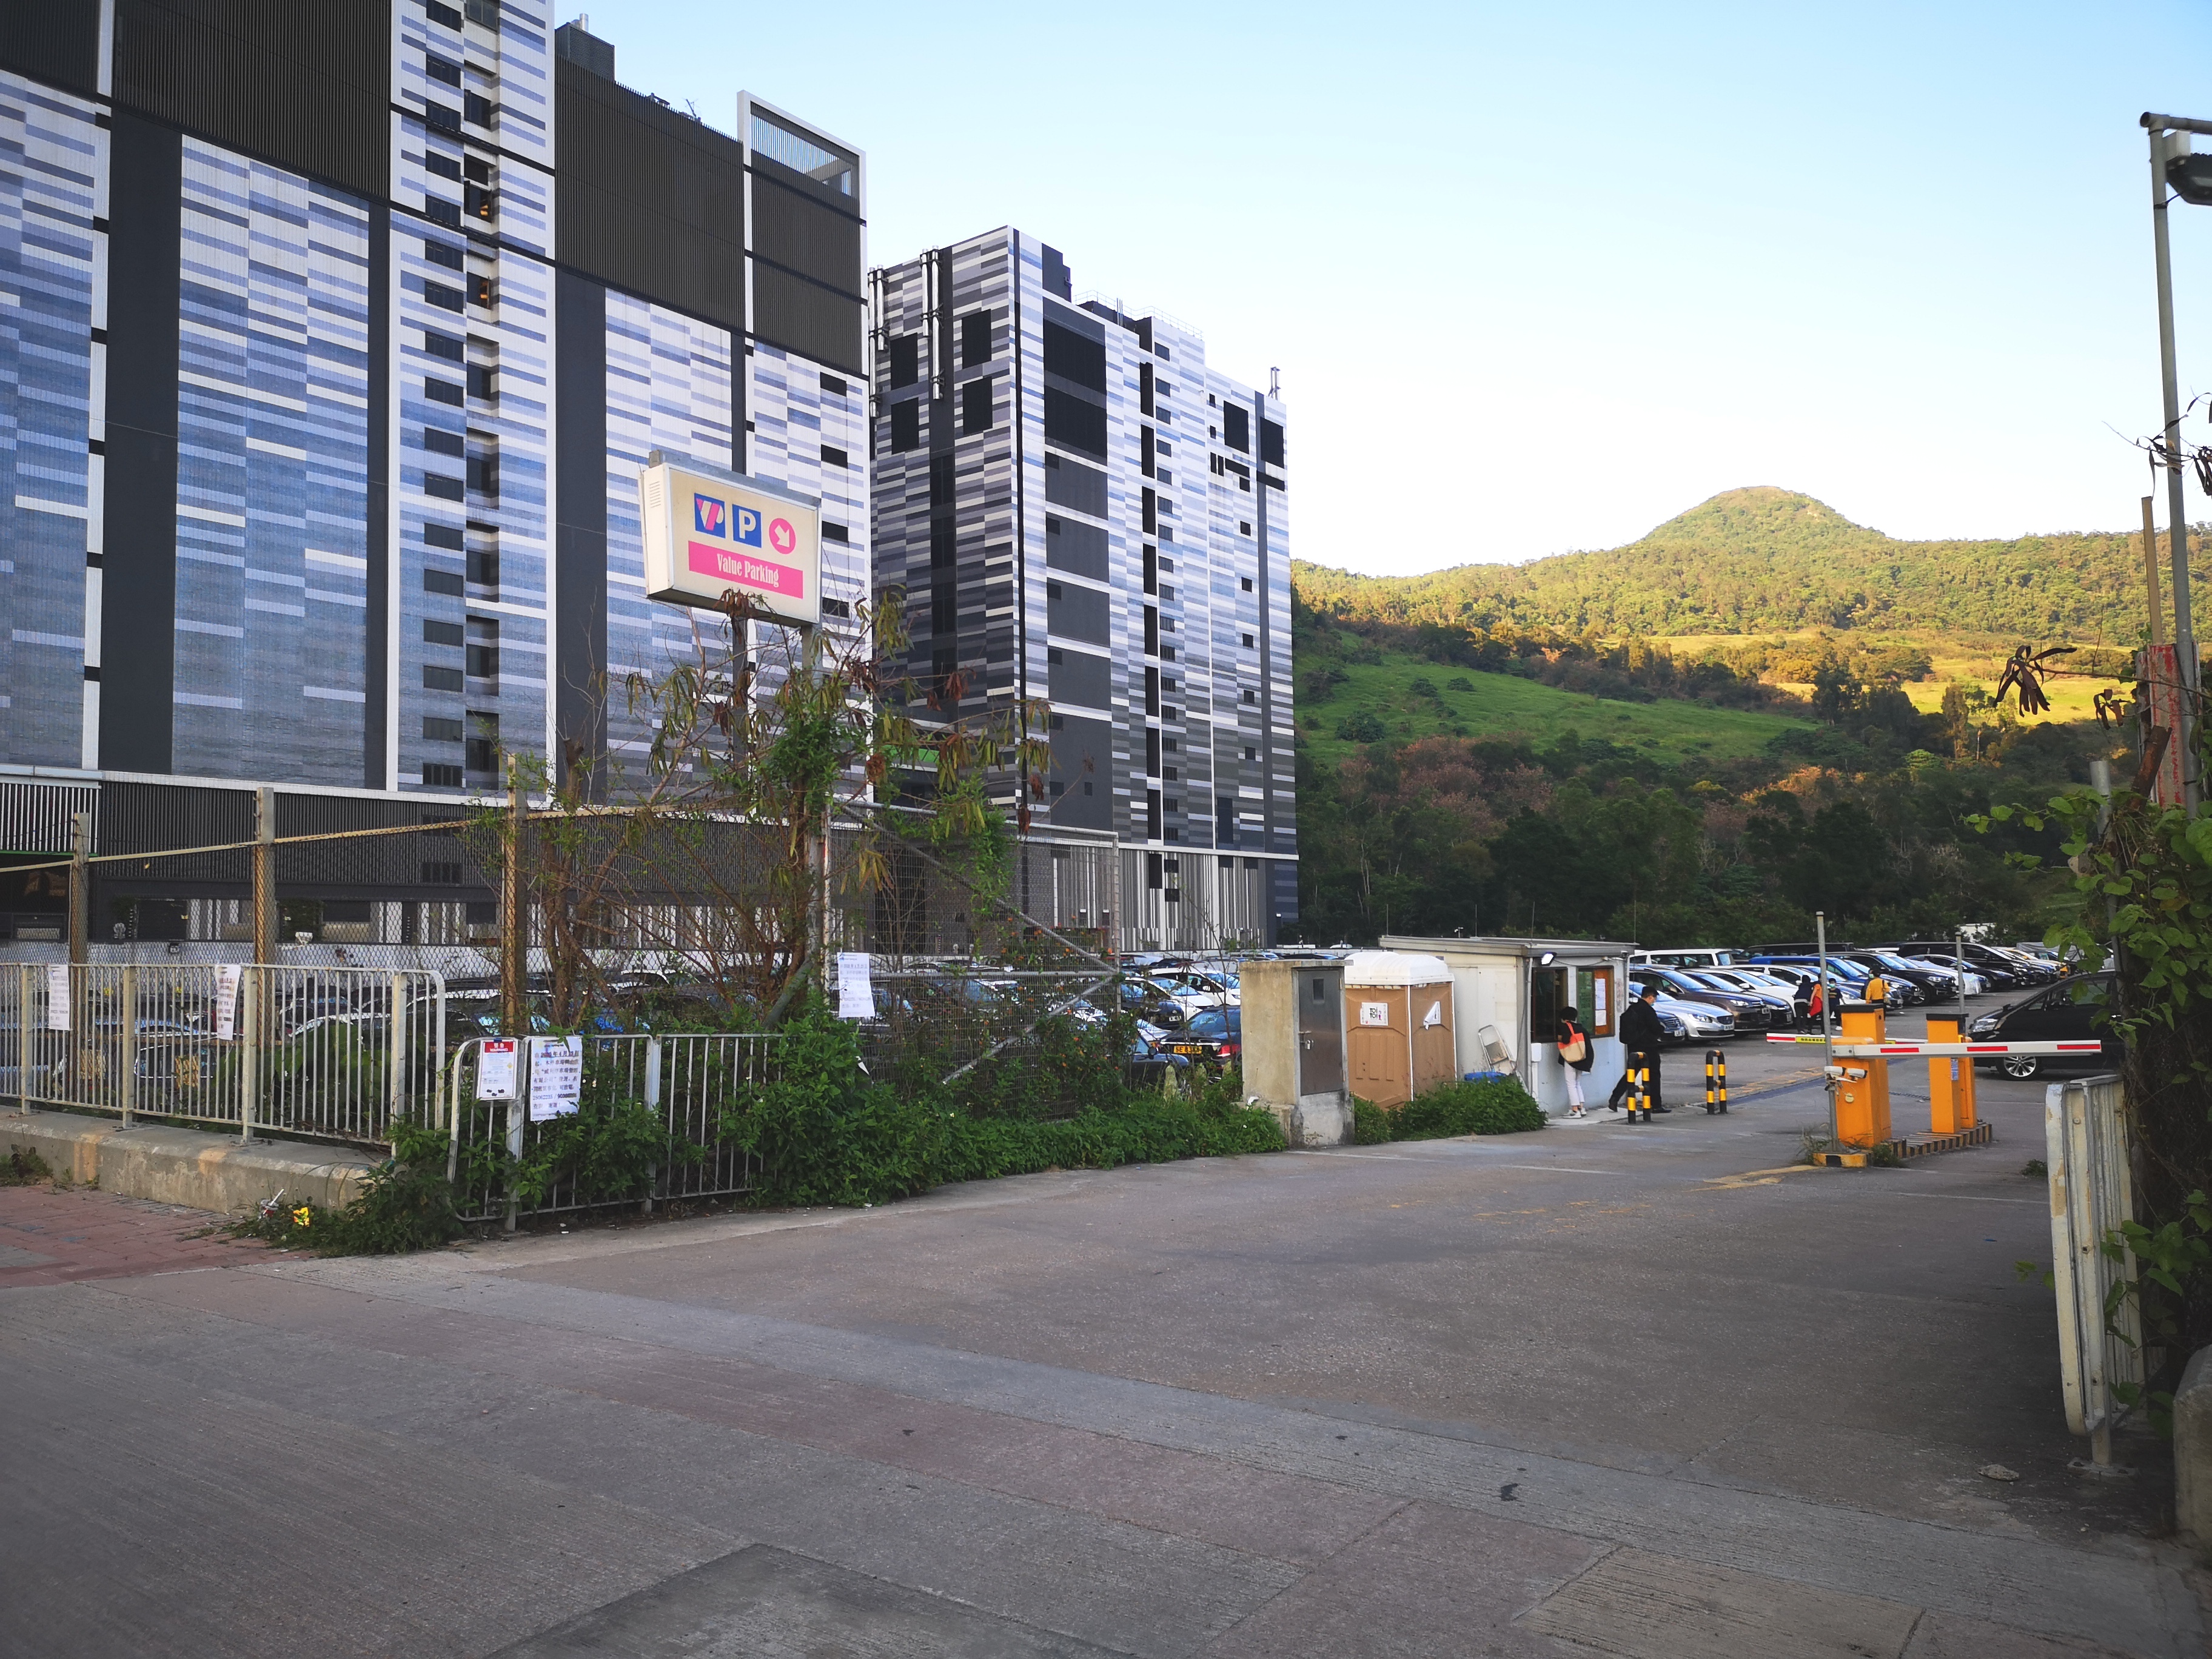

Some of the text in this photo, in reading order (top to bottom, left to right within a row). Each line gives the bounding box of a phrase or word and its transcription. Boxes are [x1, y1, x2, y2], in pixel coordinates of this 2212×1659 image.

[739, 508, 757, 540] P
[717, 553, 779, 588] Value Parking
